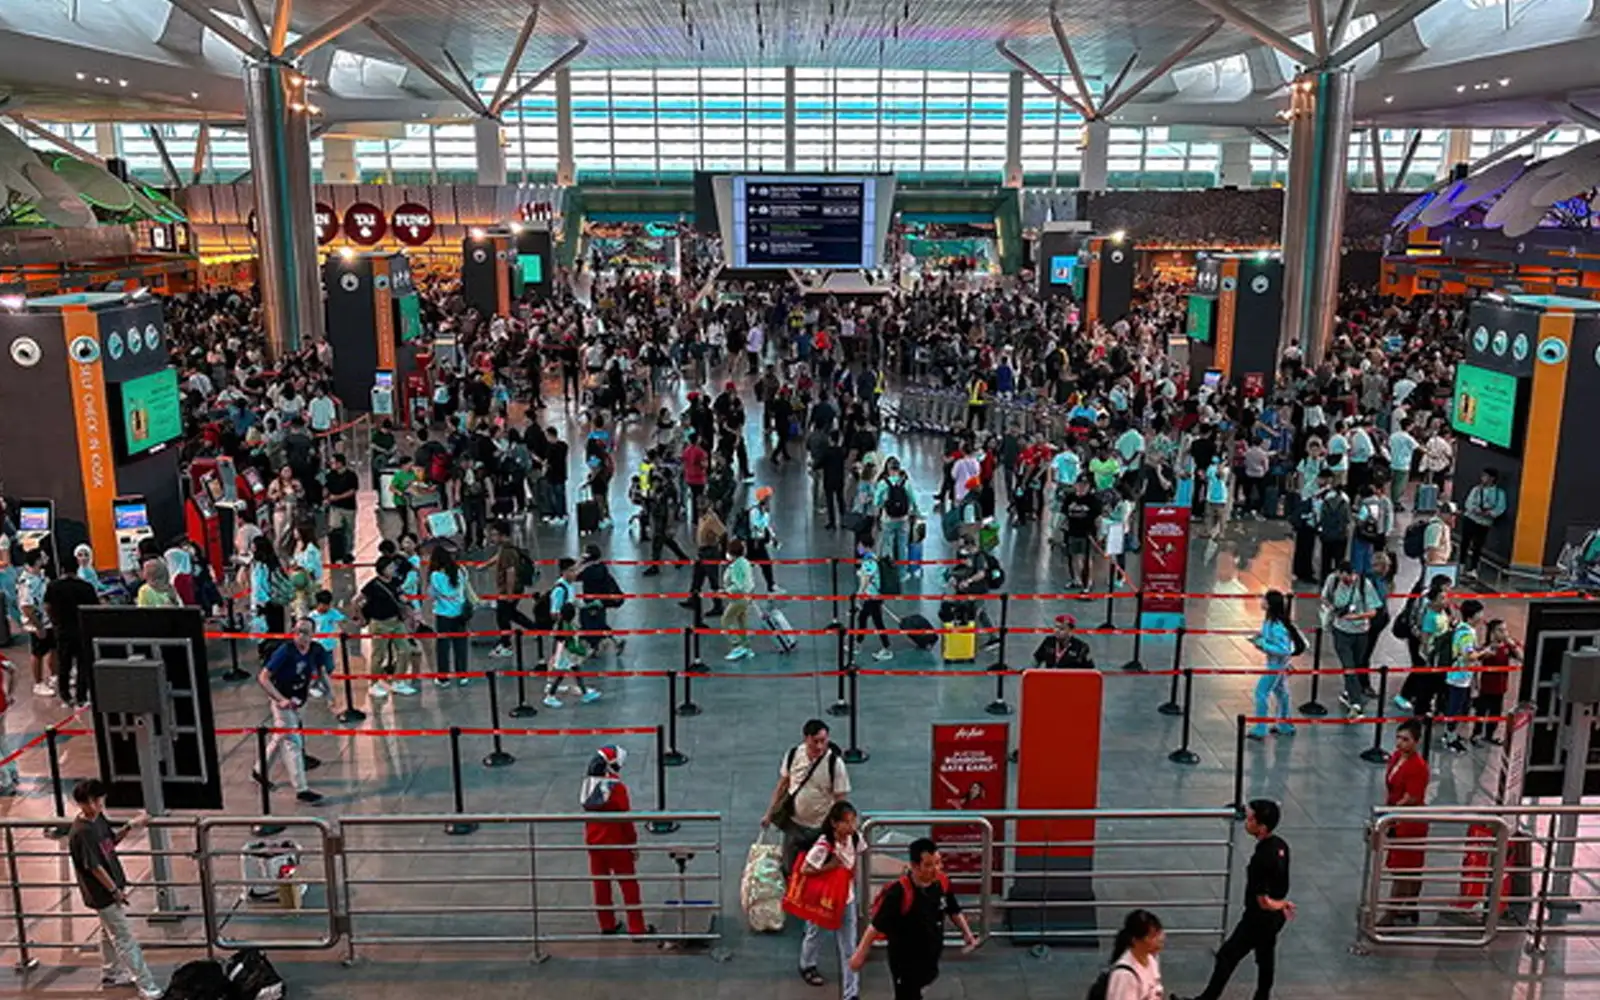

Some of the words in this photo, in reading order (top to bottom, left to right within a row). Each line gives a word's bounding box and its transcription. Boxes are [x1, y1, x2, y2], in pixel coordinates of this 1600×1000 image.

[315, 213, 330, 225] IN
[352, 213, 376, 226] TAI
[395, 213, 431, 226] FUNG
[83, 393, 99, 432] CHECK
[91, 453, 104, 488] KIOSK
[940, 763, 963, 772] GATE
